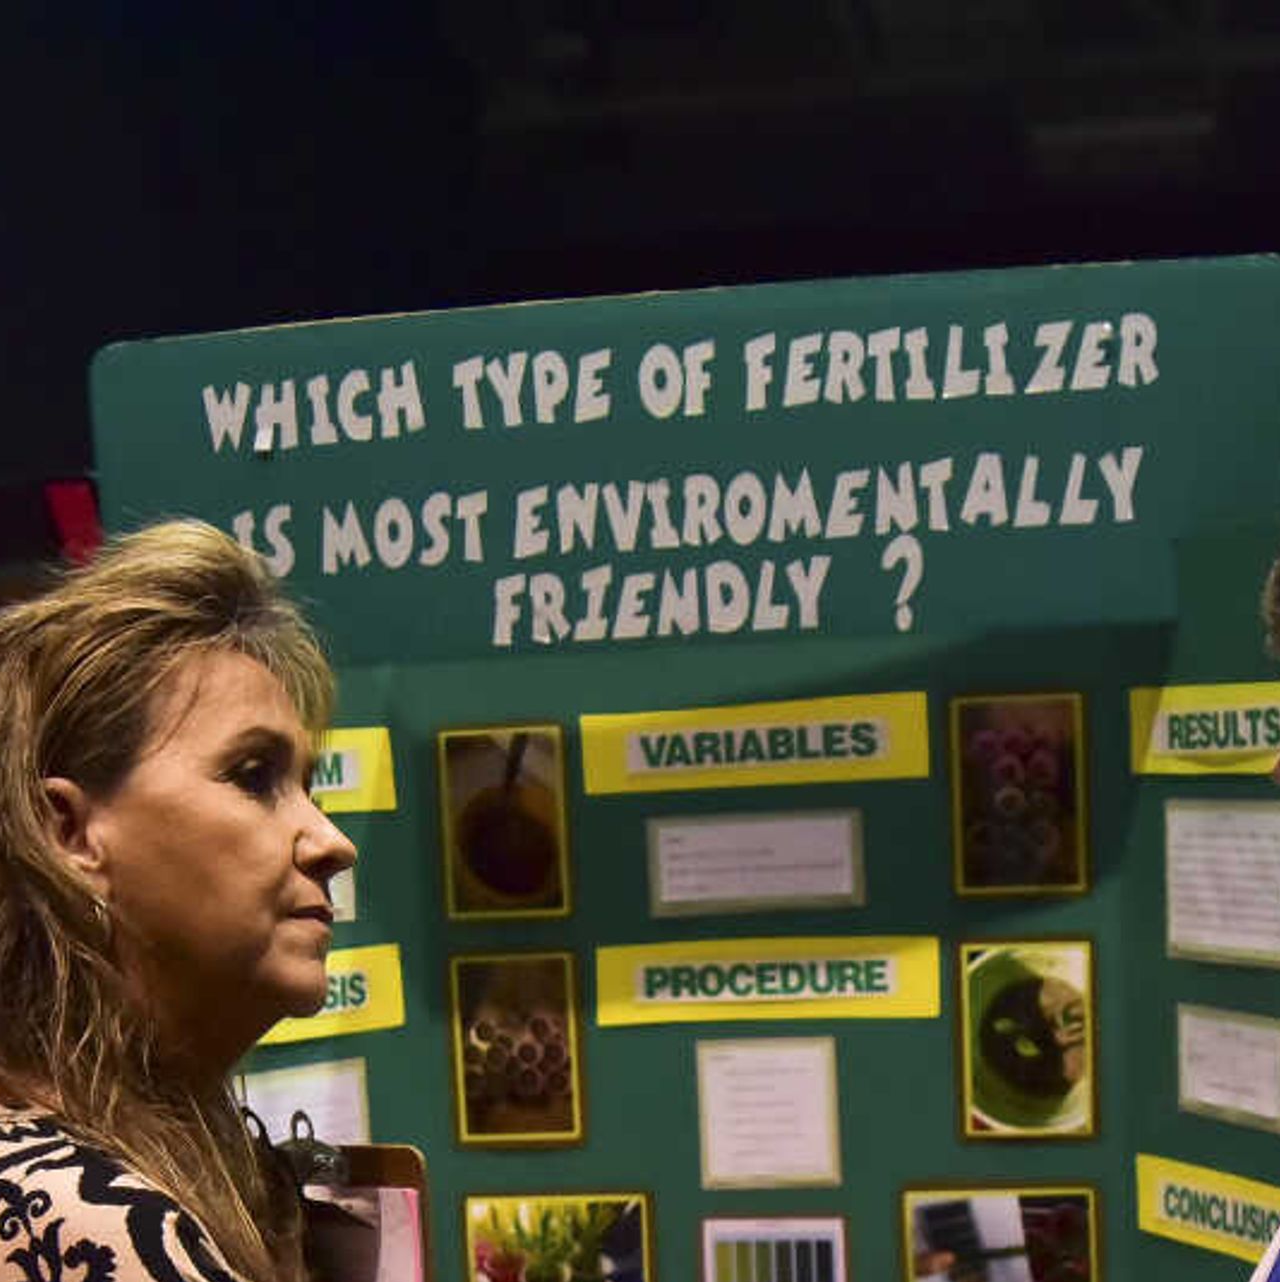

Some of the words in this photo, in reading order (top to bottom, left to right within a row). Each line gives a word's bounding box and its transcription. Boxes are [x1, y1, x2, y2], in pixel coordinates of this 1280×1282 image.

[202, 360, 425, 453] WHICH
[452, 347, 613, 429] TYPE
[637, 340, 716, 419] OF
[744, 312, 1159, 411] FERTILIZER
[322, 490, 489, 574] MOST
[513, 446, 1144, 559] ENVIROMENTALLY
[492, 555, 832, 646] FRIENDLY
[880, 534, 924, 632] ?
[639, 721, 879, 768] VARIABLES
[642, 958, 889, 999] PROCEDURE
